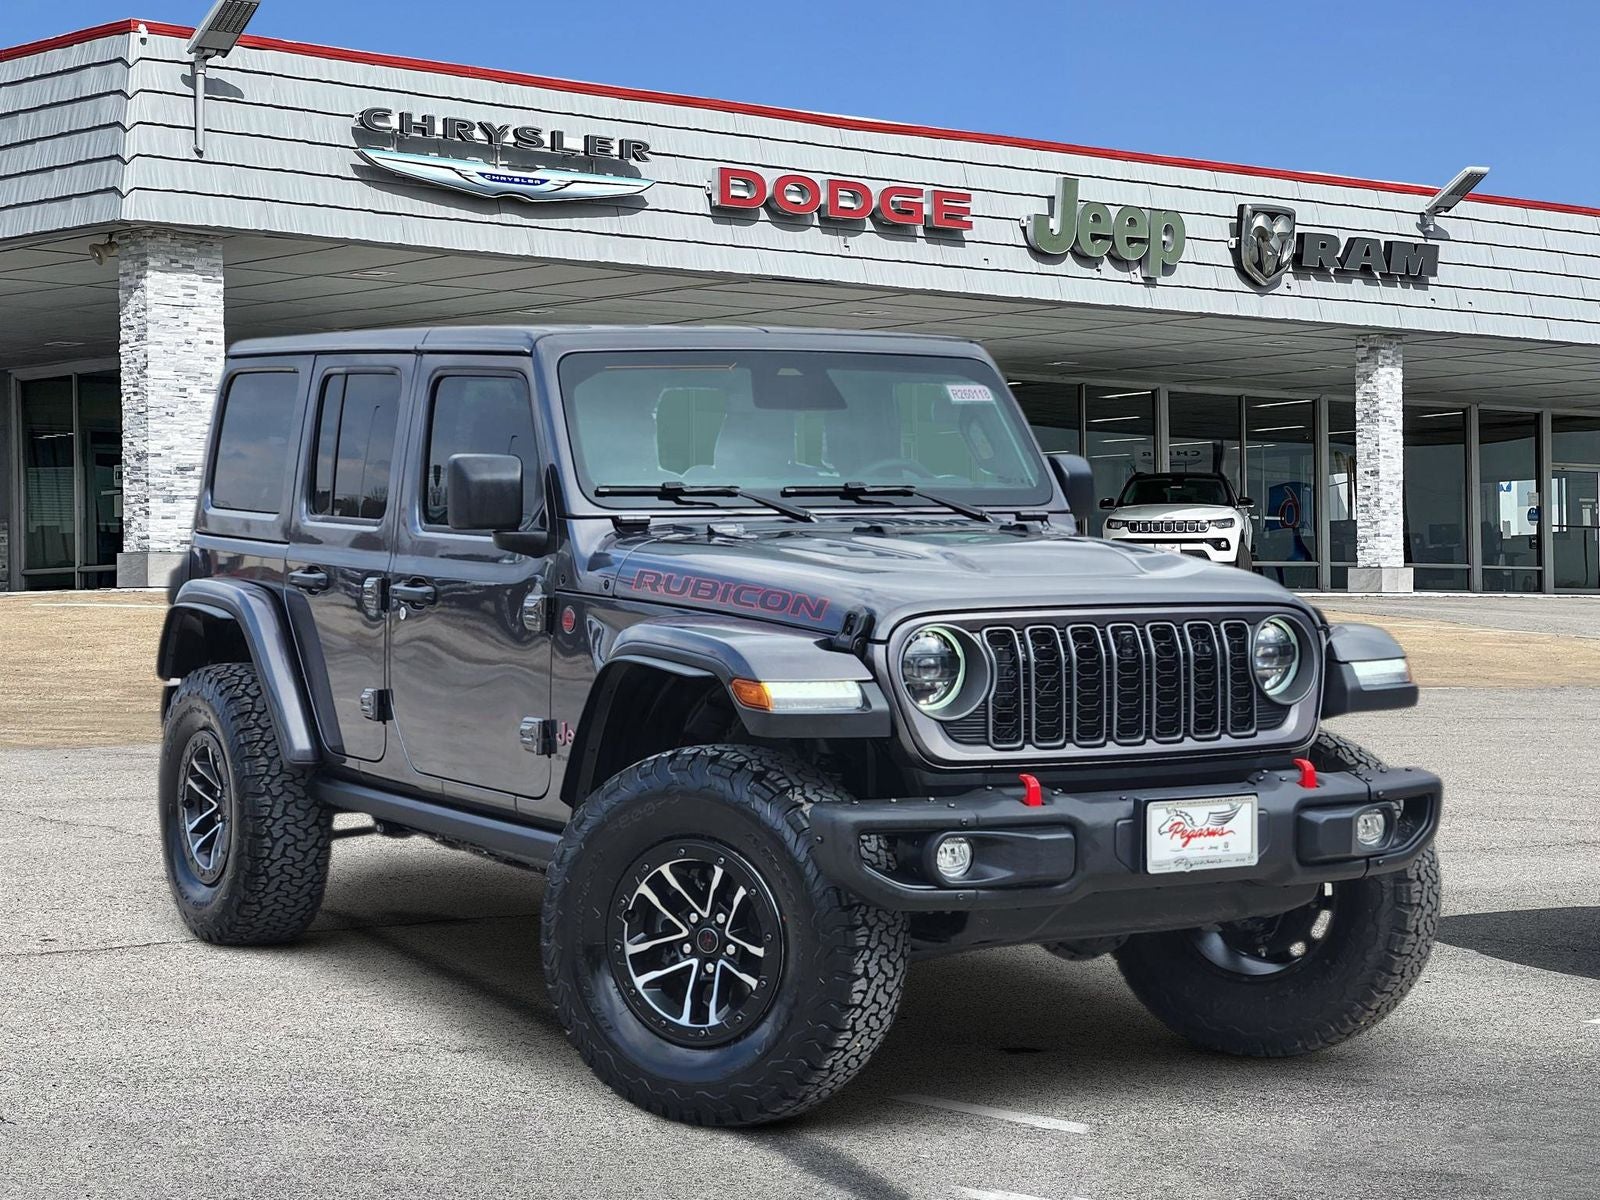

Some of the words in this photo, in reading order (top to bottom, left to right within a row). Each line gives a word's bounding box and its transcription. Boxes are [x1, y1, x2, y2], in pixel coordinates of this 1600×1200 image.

[357, 107, 651, 162] CHRYSLER
[484, 174, 541, 185] CHRYSLER
[711, 166, 974, 230] DODGE
[1026, 177, 1186, 278] Jeep
[1298, 231, 1440, 277] RAM
[632, 568, 831, 622] RUBICON
[1168, 821, 1236, 848] Pegasus
